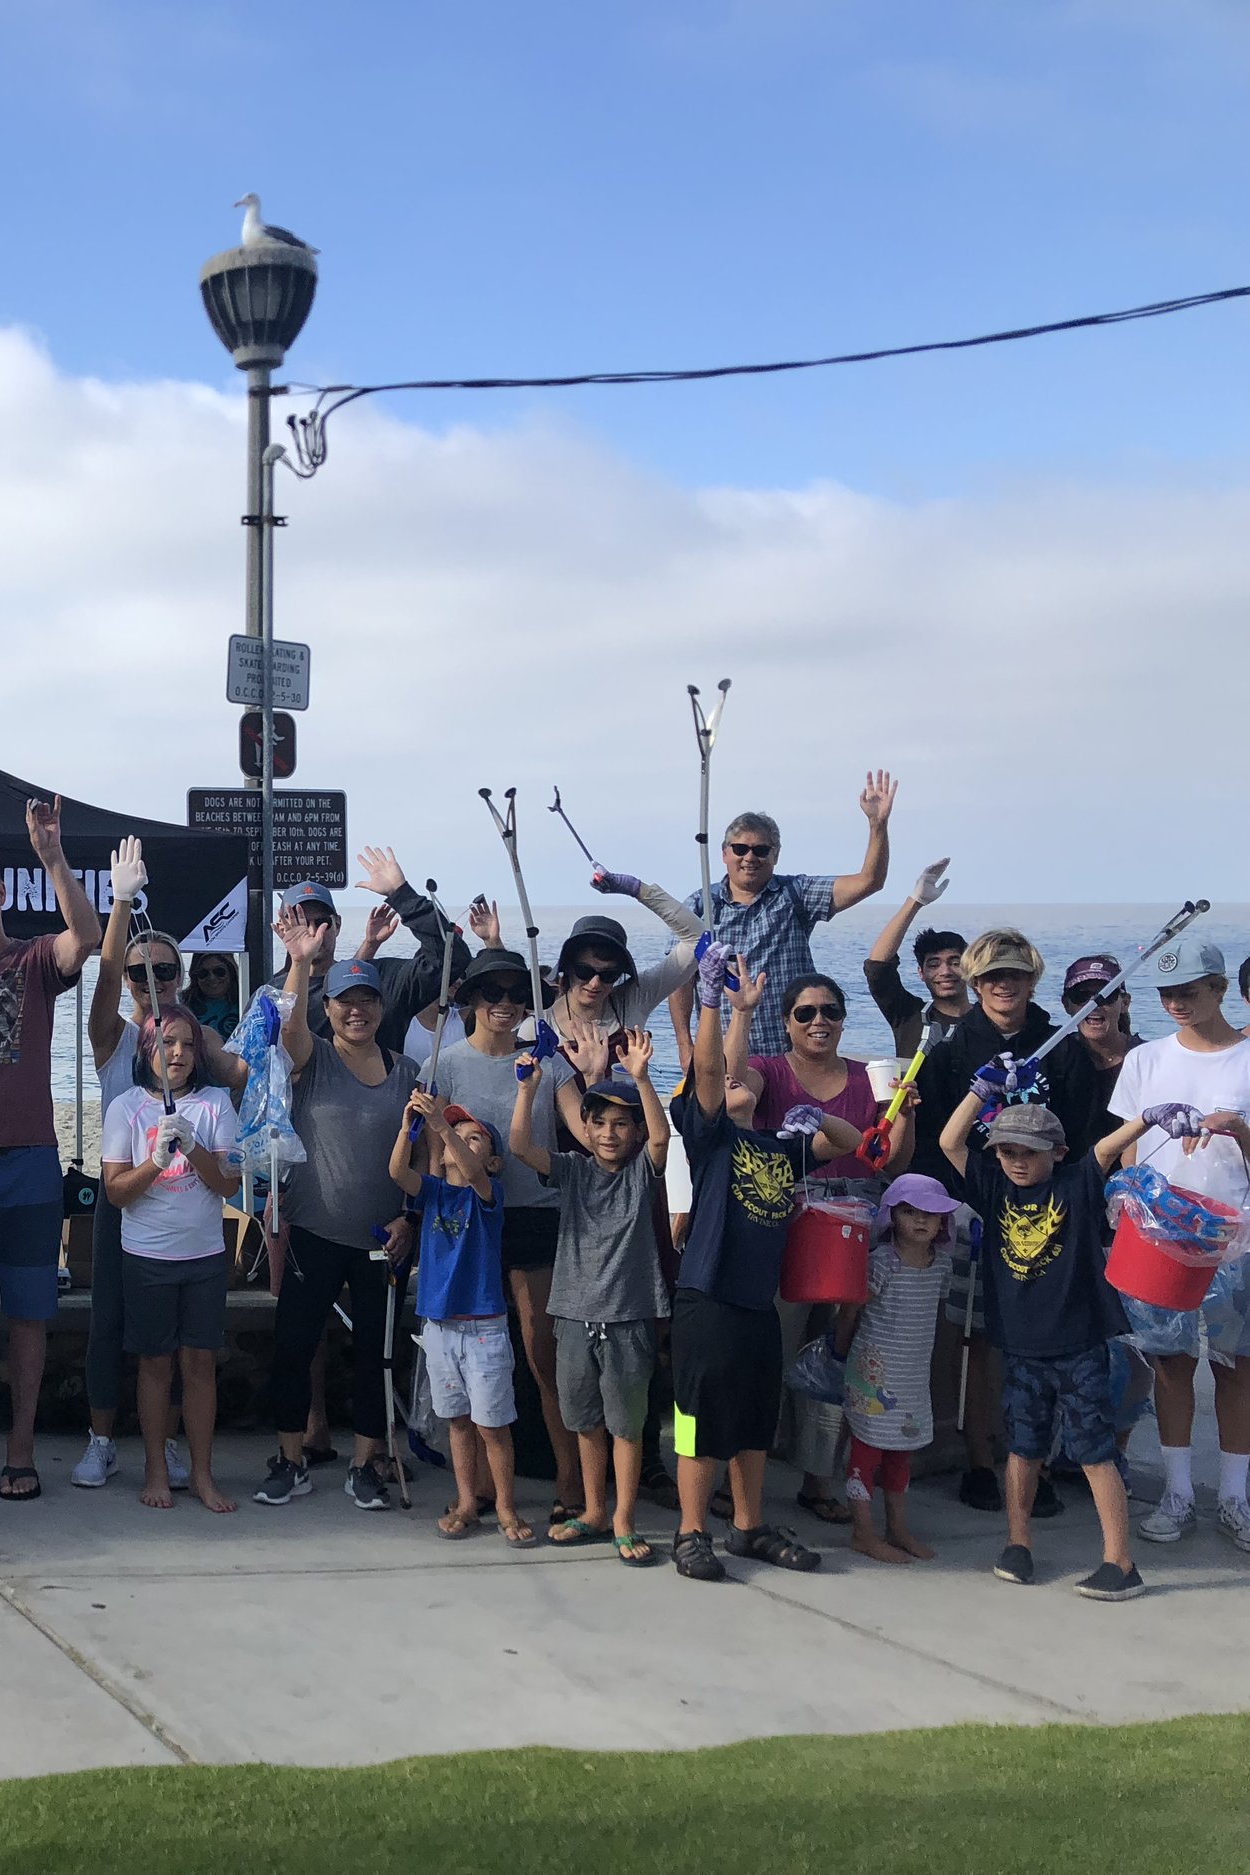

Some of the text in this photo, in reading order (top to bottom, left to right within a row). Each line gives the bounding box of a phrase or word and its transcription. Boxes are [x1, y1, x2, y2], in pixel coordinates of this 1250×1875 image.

[272, 647, 296, 660] ATING
[299, 651, 304, 661] &
[239, 657, 300, 674] SKATEARDING
[246, 673, 292, 688] PROITED
[204, 797, 332, 809] DOGS ARE NOT RMITTED ON THE
[195, 811, 340, 823] BEACHES BETWEE AM AND 6PM FROM
[245, 826, 287, 837] SEPTBER
[308, 827, 327, 837] DOGS
[329, 827, 343, 837] ARE
[251, 841, 341, 851] OF EASH AT ANY TIME.
[295, 856, 315, 866] YOUR
[316, 856, 332, 866] PET.
[306, 871, 345, 883] 2-5-39(d)
[731, 1183, 744, 1200] CUB
[743, 1199, 768, 1218] SCOUT
